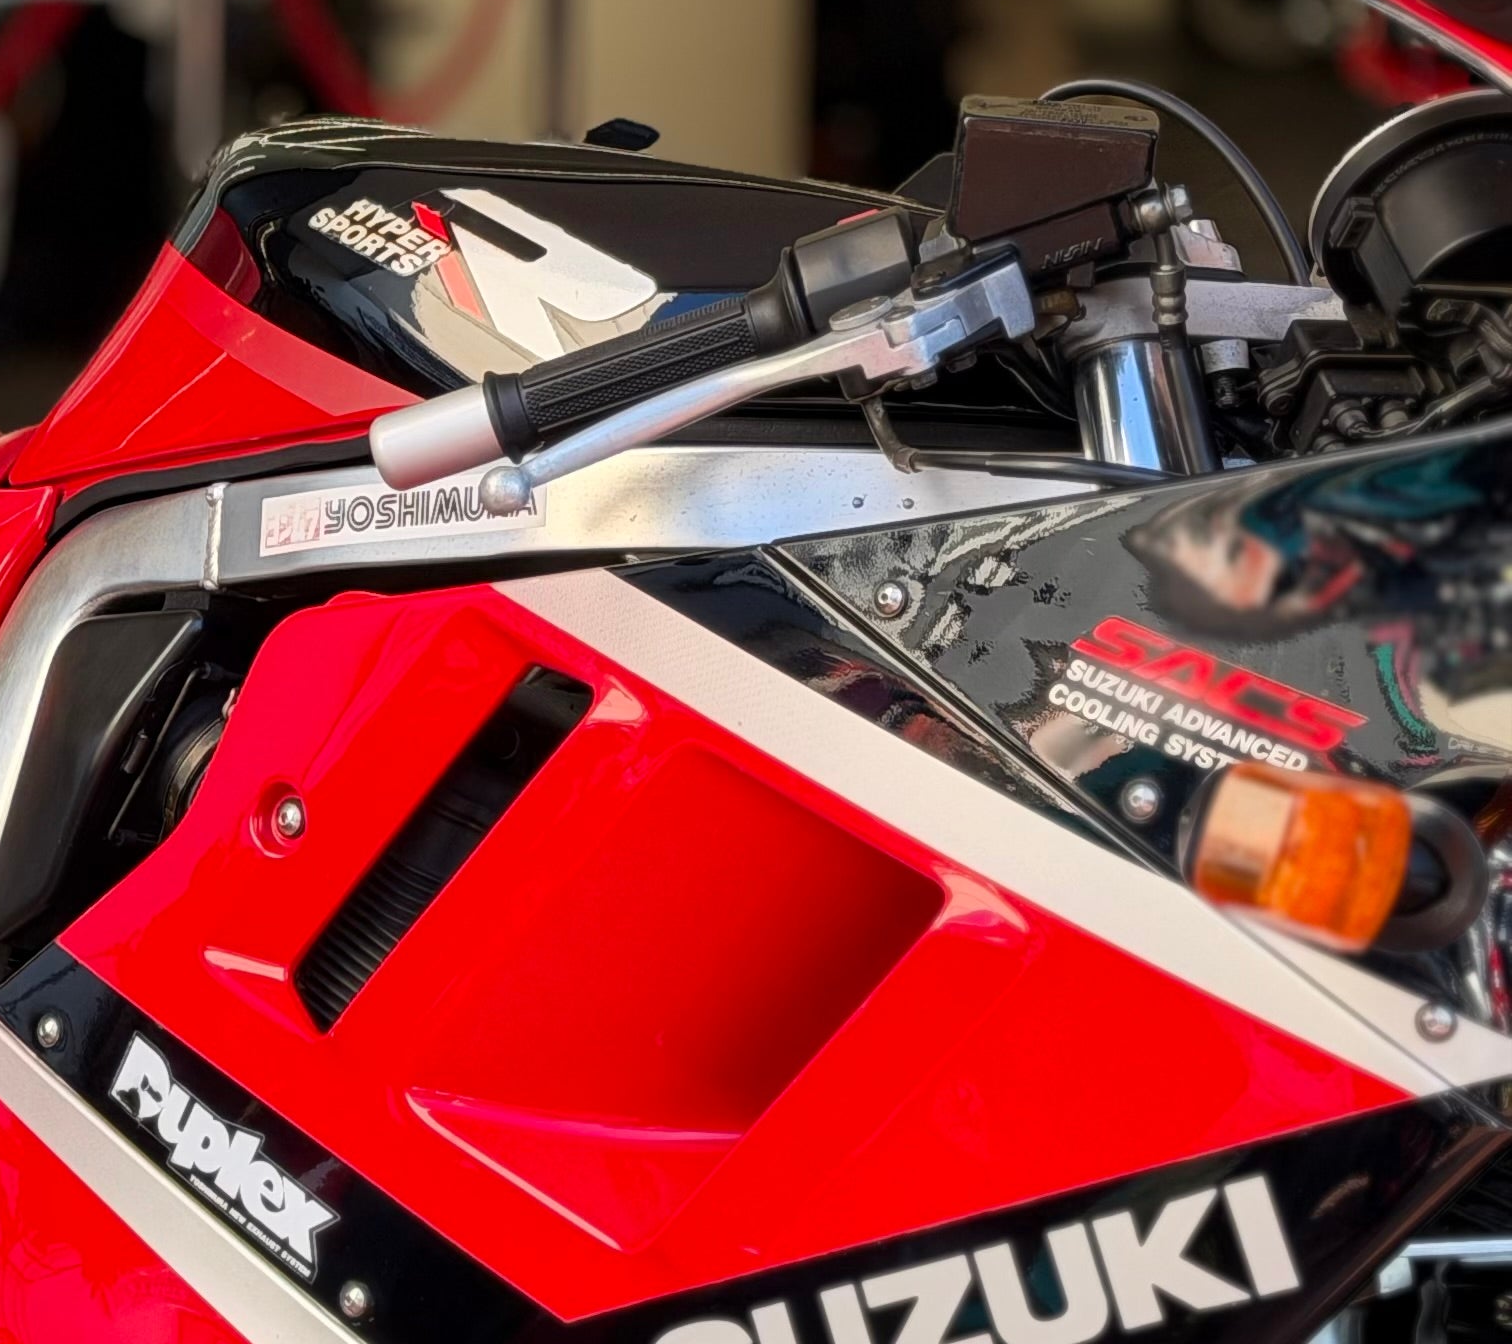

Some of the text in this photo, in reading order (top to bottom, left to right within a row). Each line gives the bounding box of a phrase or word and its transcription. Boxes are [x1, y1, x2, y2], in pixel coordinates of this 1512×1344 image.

[308, 207, 422, 278] SPORTS
[343, 198, 451, 262] HYPER
[1048, 683, 1238, 771] COOLING SYST
[1066, 659, 1309, 772] SUZUKI ADVANCED
[1070, 615, 1369, 751] SACS
[112, 1034, 338, 1264] Duplex
[246, 1222, 281, 1252] EXHAUST
